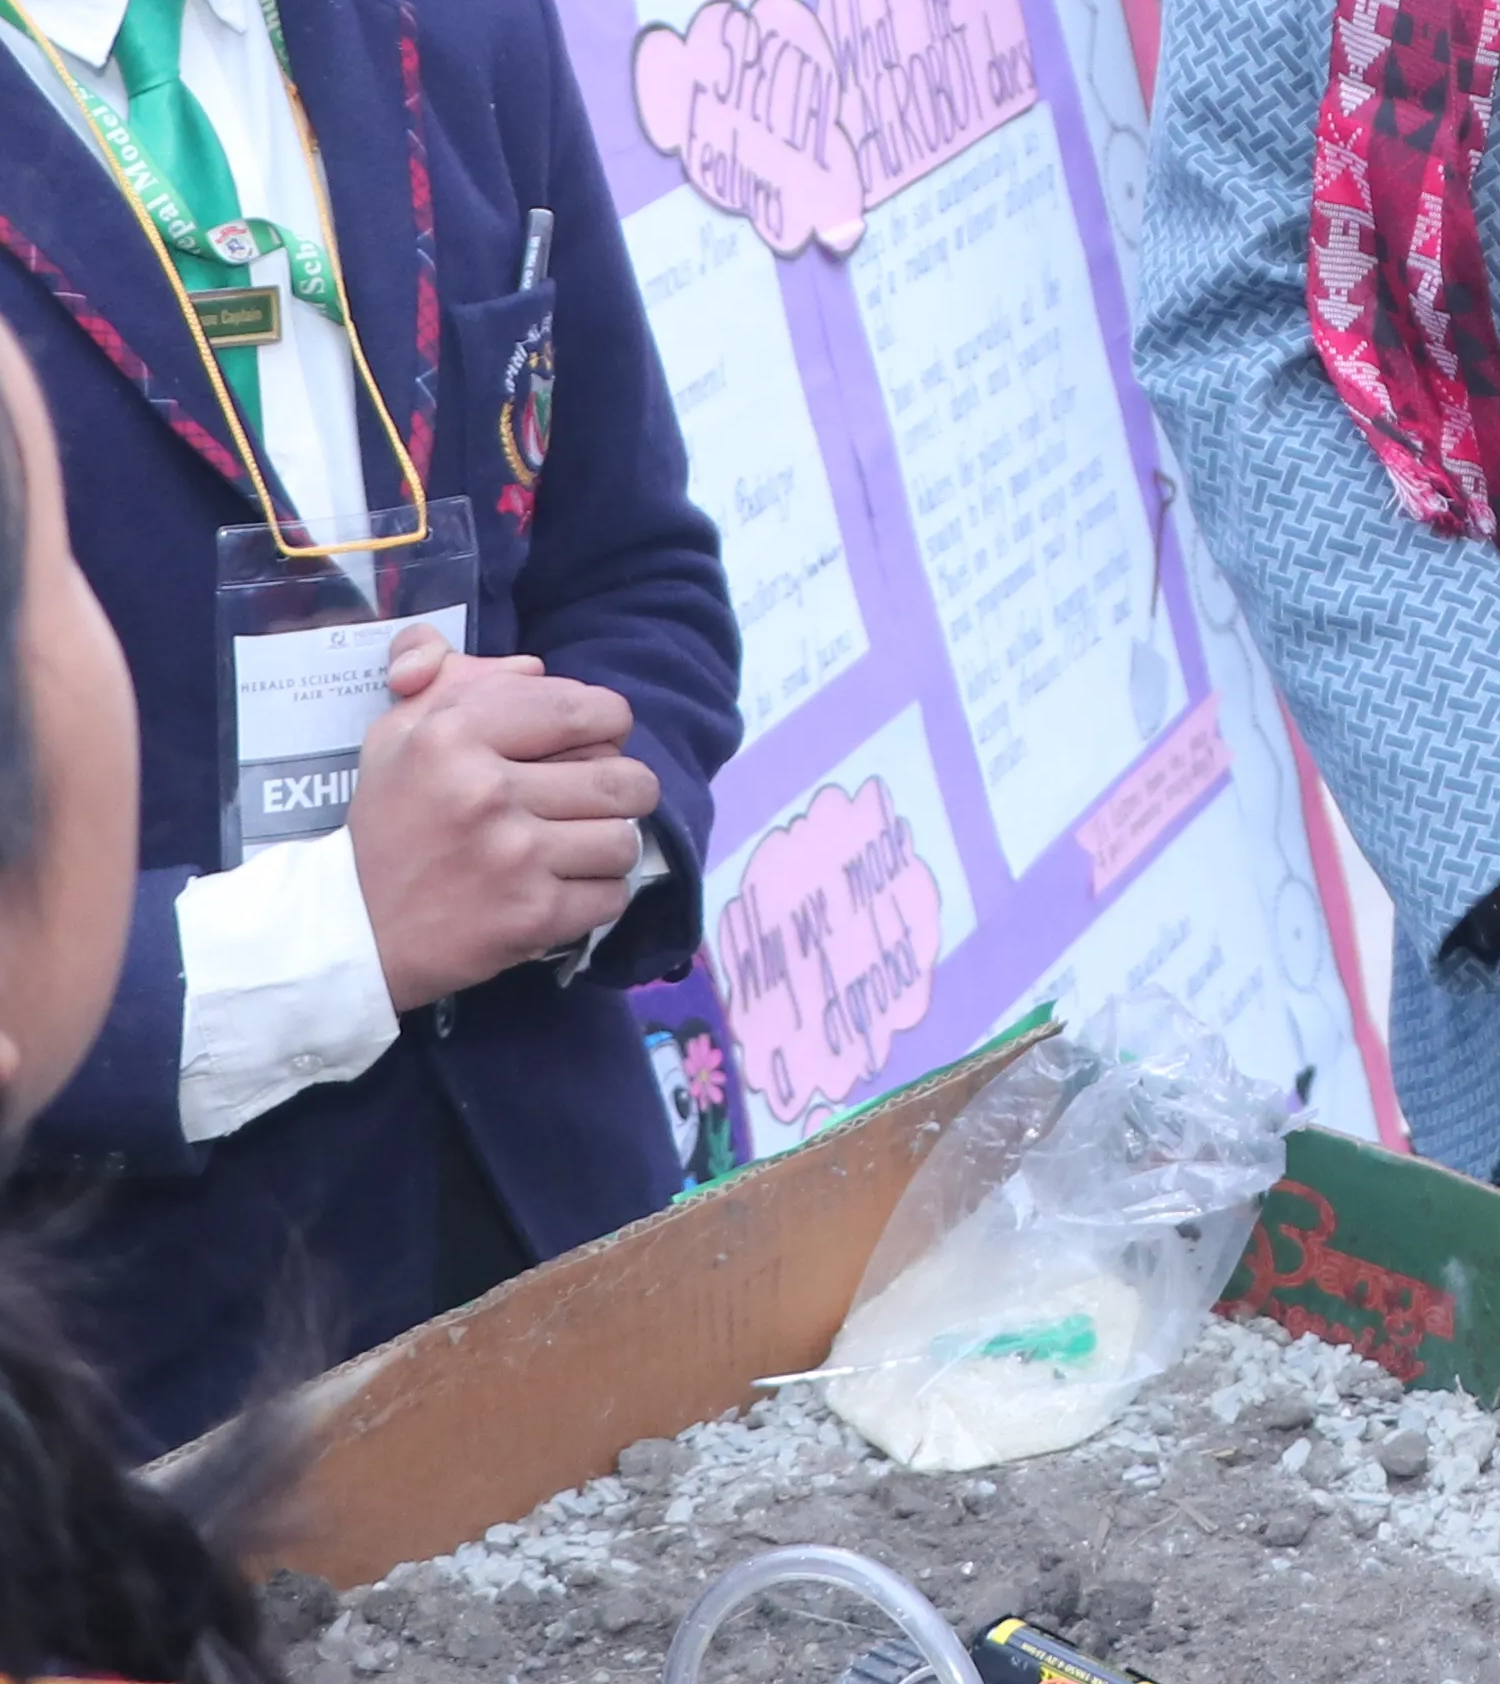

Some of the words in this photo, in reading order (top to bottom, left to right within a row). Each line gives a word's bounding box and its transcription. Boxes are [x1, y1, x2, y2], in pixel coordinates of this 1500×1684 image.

[712, 4, 837, 173] SPECIAL
[90, 98, 160, 193] Model
[145, 192, 203, 254] epal
[240, 677, 296, 694] HERALD
[300, 669, 360, 687] SCIENCE
[293, 687, 324, 703] FAIR
[725, 882, 803, 1031] Why
[841, 776, 910, 916] made
